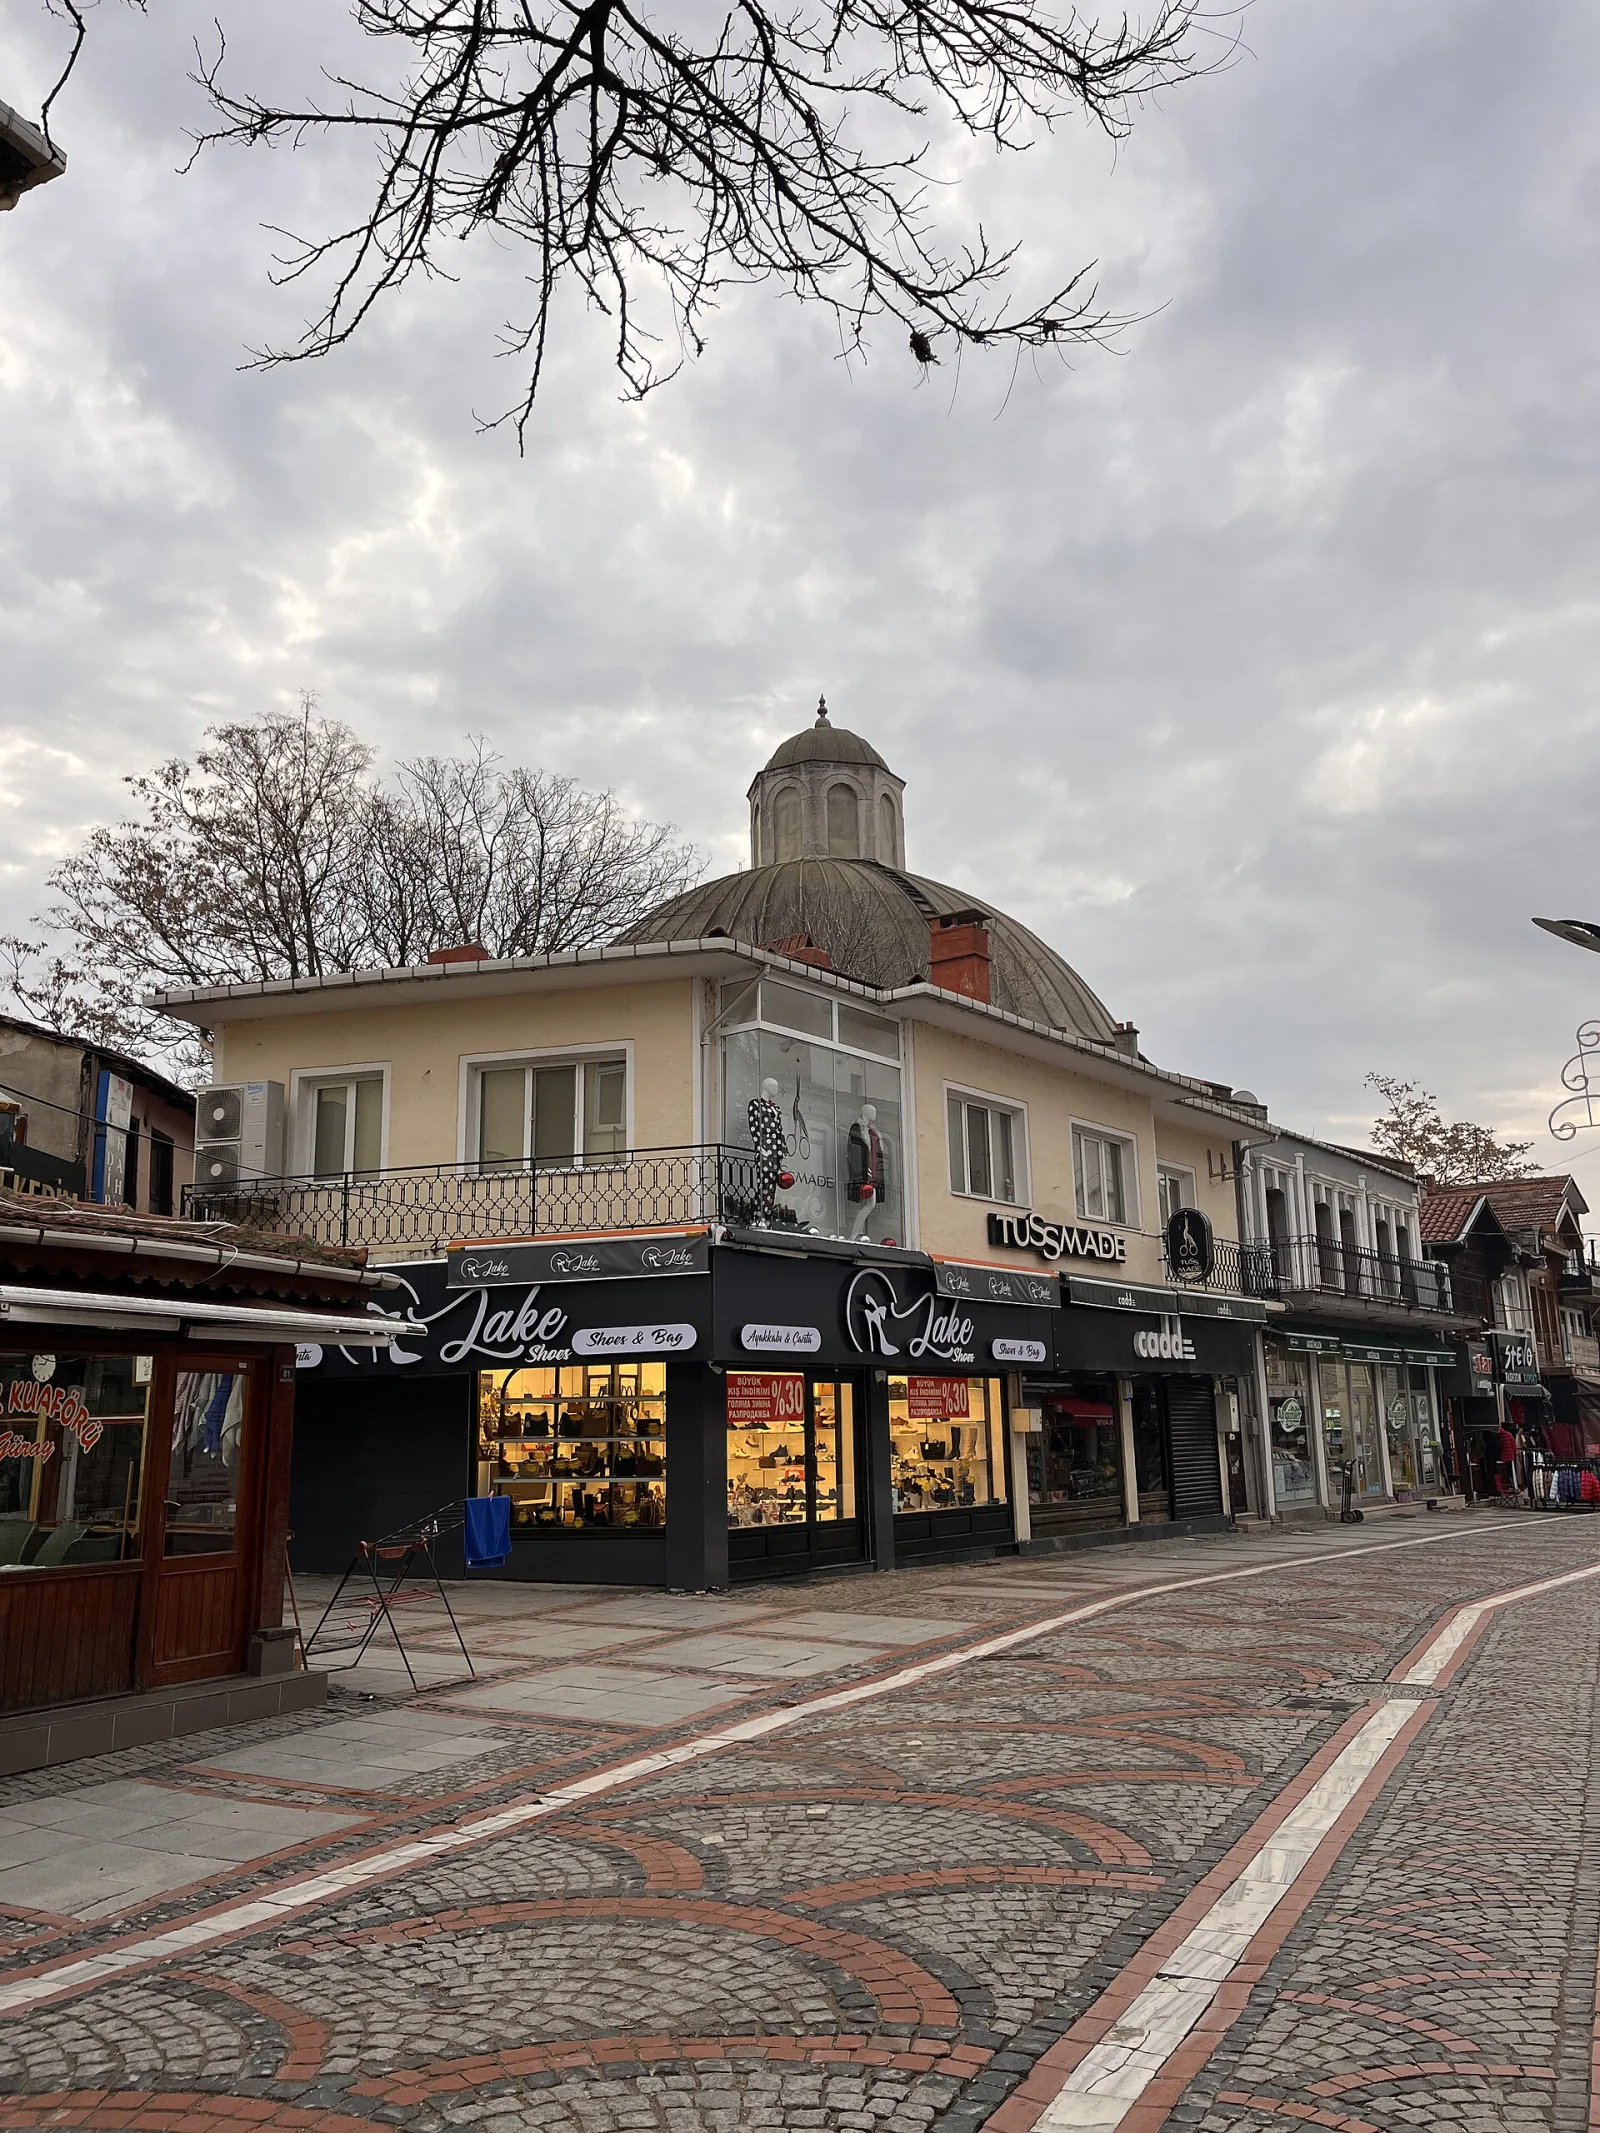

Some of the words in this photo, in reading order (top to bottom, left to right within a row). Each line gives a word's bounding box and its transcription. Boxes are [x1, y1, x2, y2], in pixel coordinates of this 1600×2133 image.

[996, 1212, 1127, 1260] TUSSMADE
[1177, 1265, 1202, 1273] MADE
[1180, 1257, 1199, 1266] TUSS
[440, 1285, 568, 1363] Lake
[909, 1292, 975, 1358] Lake
[586, 1331, 628, 1348] Shoes
[632, 1331, 644, 1345] &
[651, 1328, 684, 1347] Bag
[784, 1332, 791, 1344] &
[792, 1331, 814, 1347] Çanta
[525, 1343, 573, 1363] Shoes
[951, 1347, 976, 1363] Shoes
[998, 1344, 1016, 1356] Shoes
[1017, 1345, 1023, 1356] &
[1027, 1344, 1041, 1360] Bag
[737, 1376, 762, 1386] BÜYÜK
[916, 1379, 935, 1387] BÜYÜK
[727, 1386, 740, 1397] KIŞ
[741, 1386, 771, 1396] İNDİRİMİ
[771, 1380, 804, 1416] %30
[909, 1388, 919, 1397] KIŞ
[942, 1382, 967, 1413] %30
[727, 1400, 751, 1408] ГОЛЯМА
[8, 1380, 104, 1455] KUAFÖRÜ
[728, 1410, 771, 1420] РАЗПРОДАЖБА
